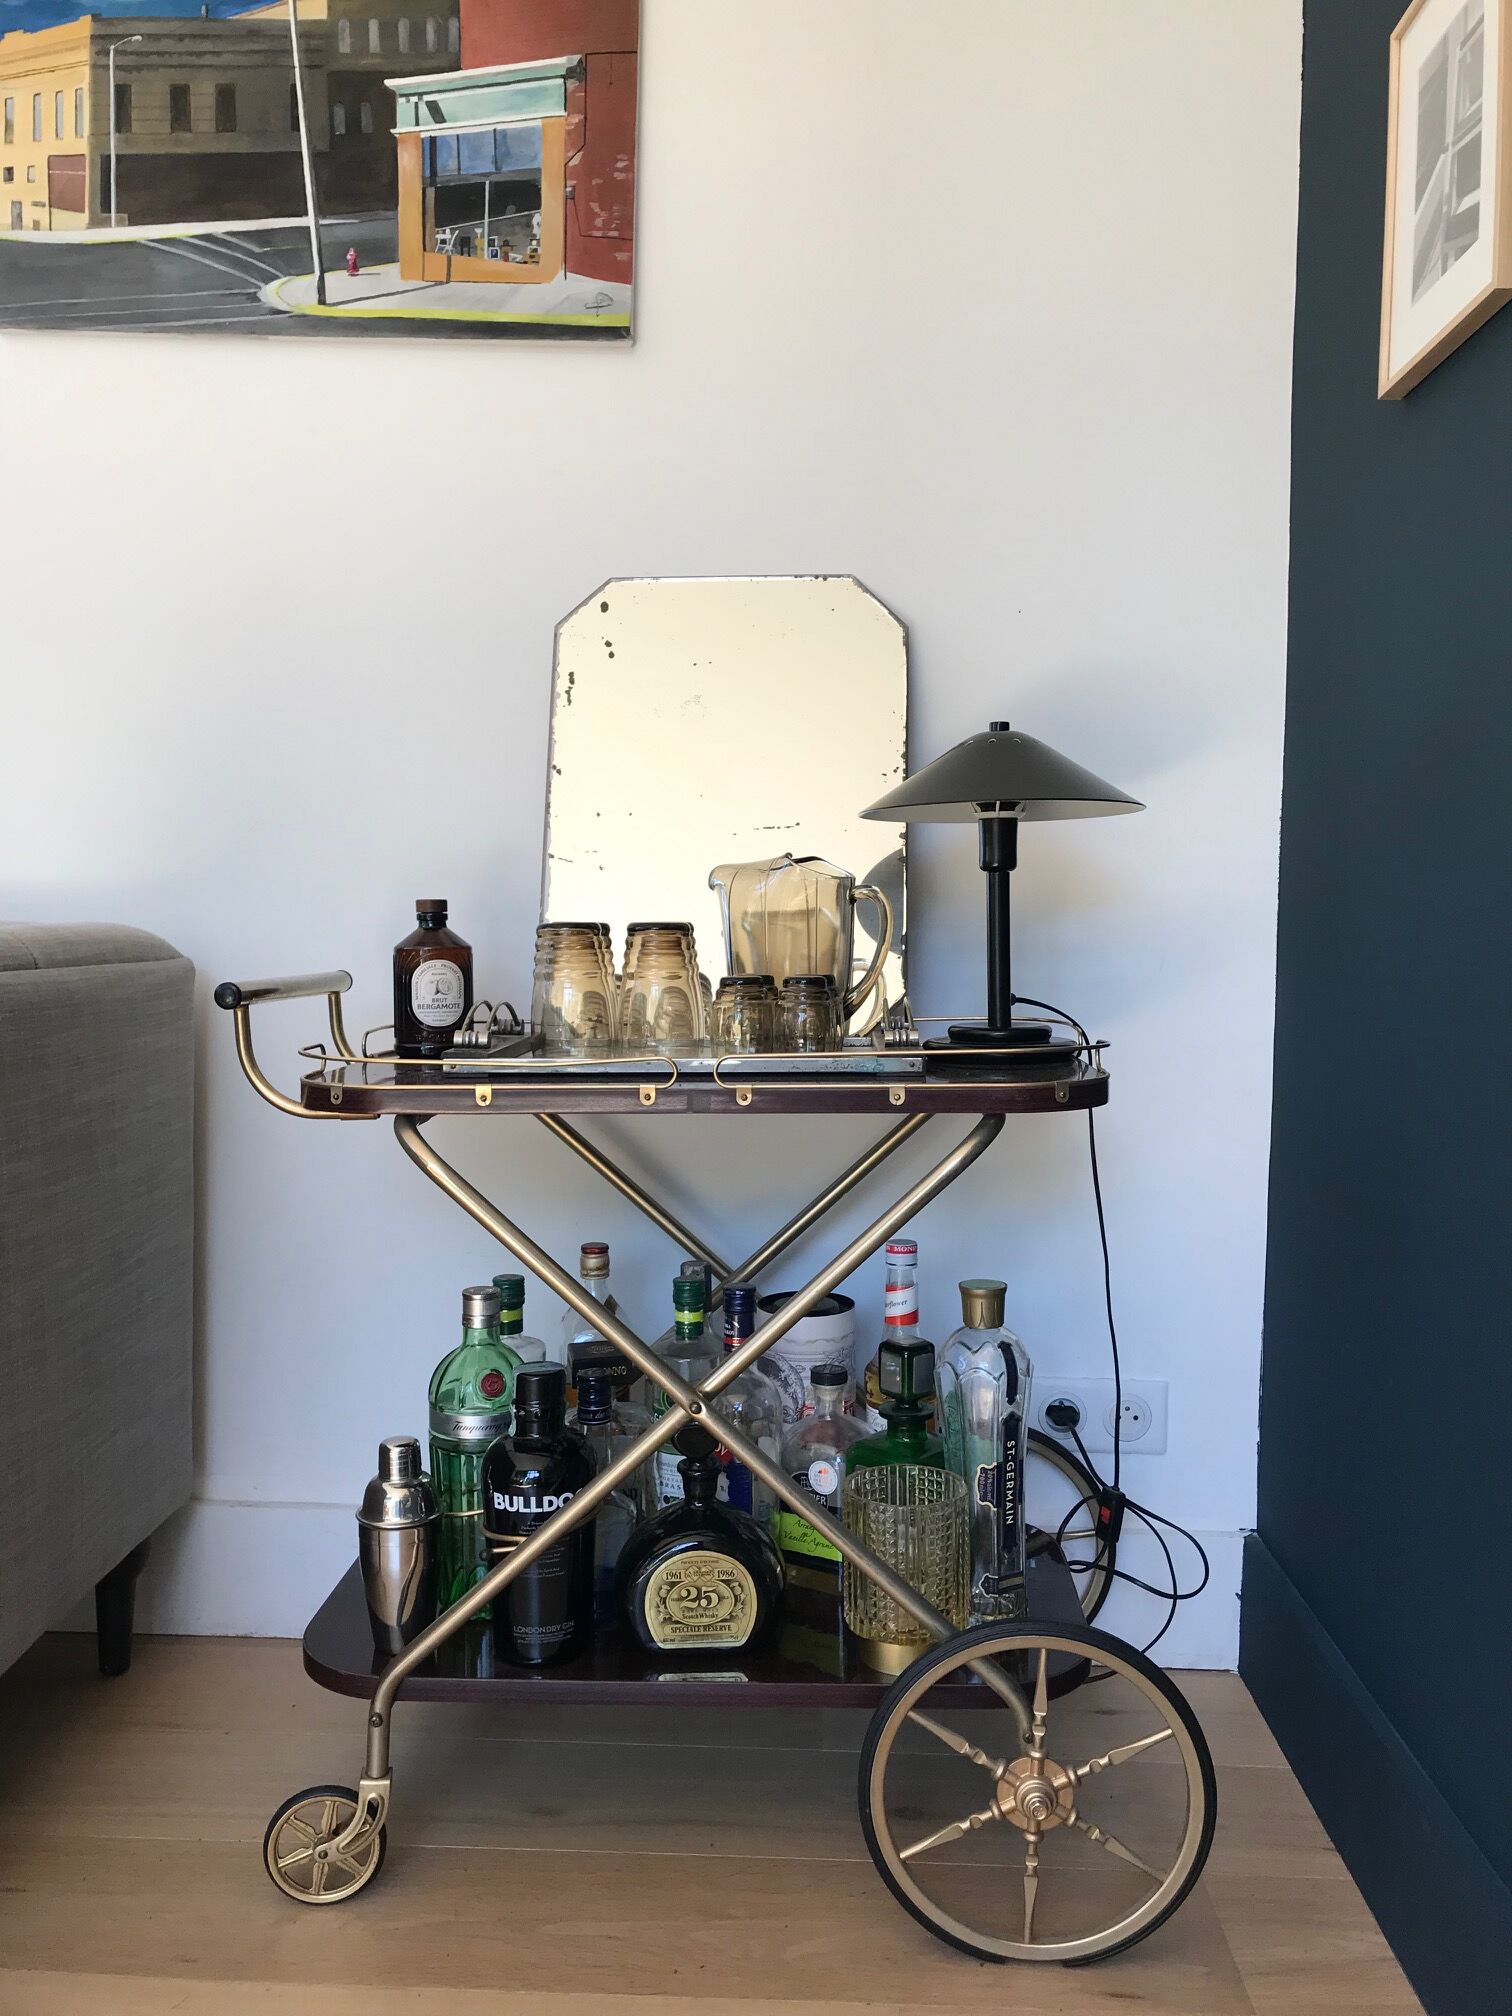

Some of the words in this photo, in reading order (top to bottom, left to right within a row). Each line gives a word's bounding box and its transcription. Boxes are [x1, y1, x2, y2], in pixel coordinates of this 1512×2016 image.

[1005, 1440, 1015, 1525] ST-GERMAIN
[493, 1488, 583, 1513] BULLDO
[665, 1571, 682, 1580] 1961
[717, 1569, 735, 1578] 1986
[680, 1586, 720, 1609] 25
[513, 1625, 545, 1634] LONDON
[546, 1624, 561, 1632] DRY
